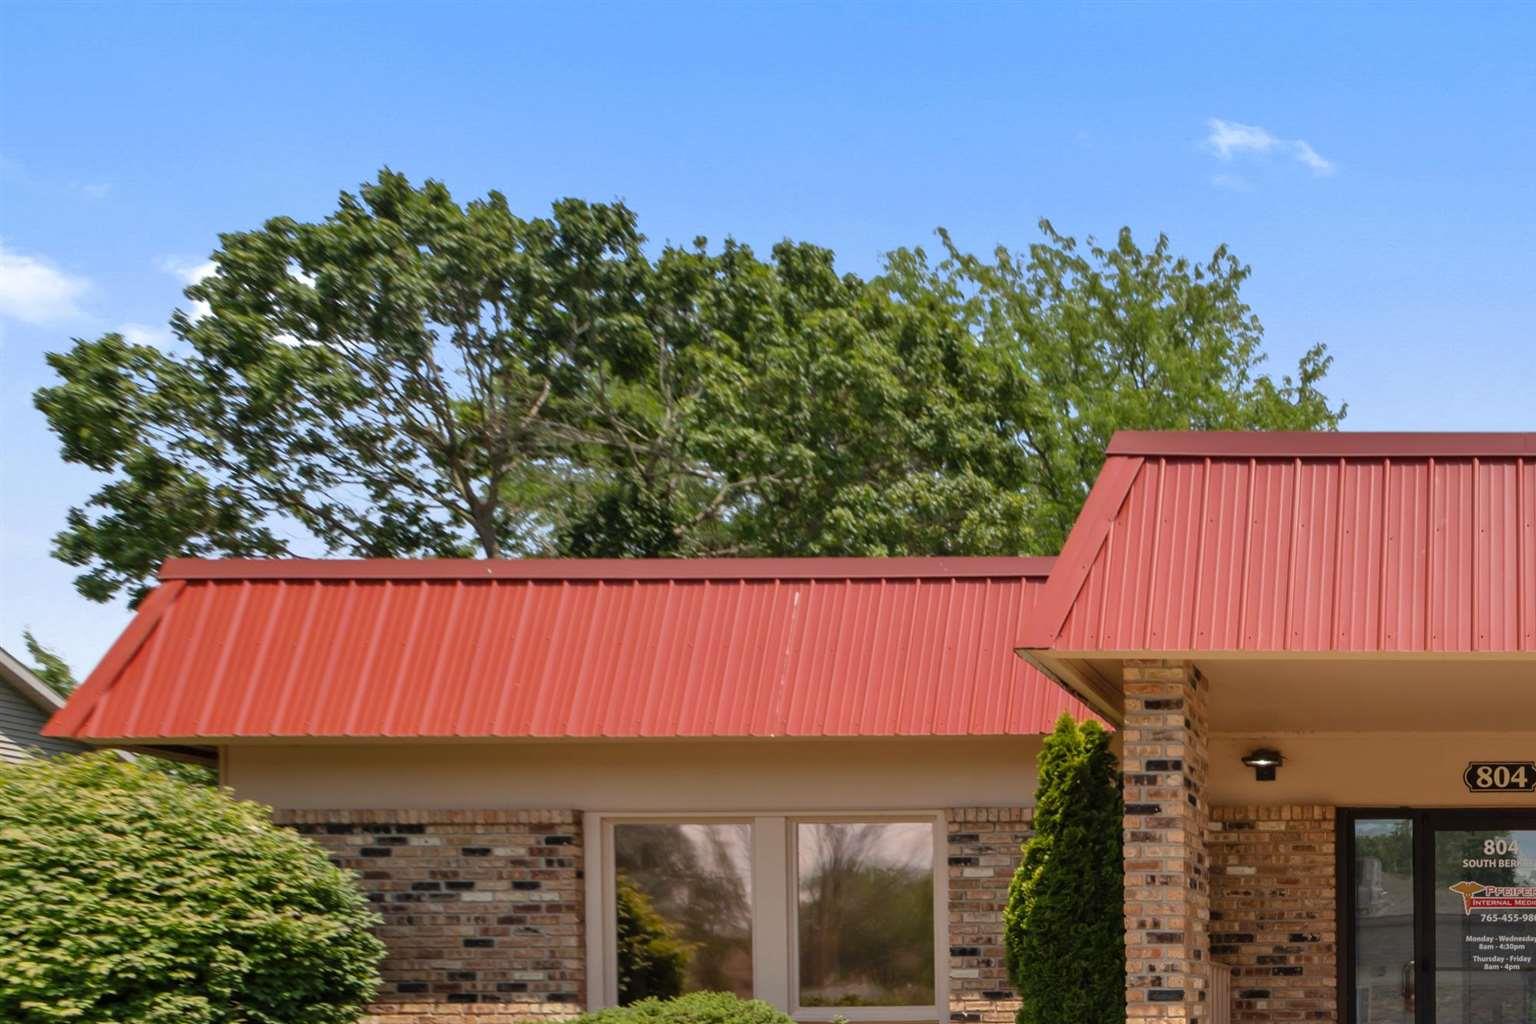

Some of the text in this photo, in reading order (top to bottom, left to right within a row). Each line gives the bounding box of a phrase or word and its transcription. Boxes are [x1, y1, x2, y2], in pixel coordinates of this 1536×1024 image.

[1476, 765, 1528, 788] 804
[1483, 839, 1519, 855] 804
[1462, 859, 1496, 868] SOUTH
[1465, 935, 1494, 943] Monday
[1473, 955, 1505, 963] Thursday
[1509, 955, 1532, 963] Friday
[1504, 963, 1520, 971] 4pm
